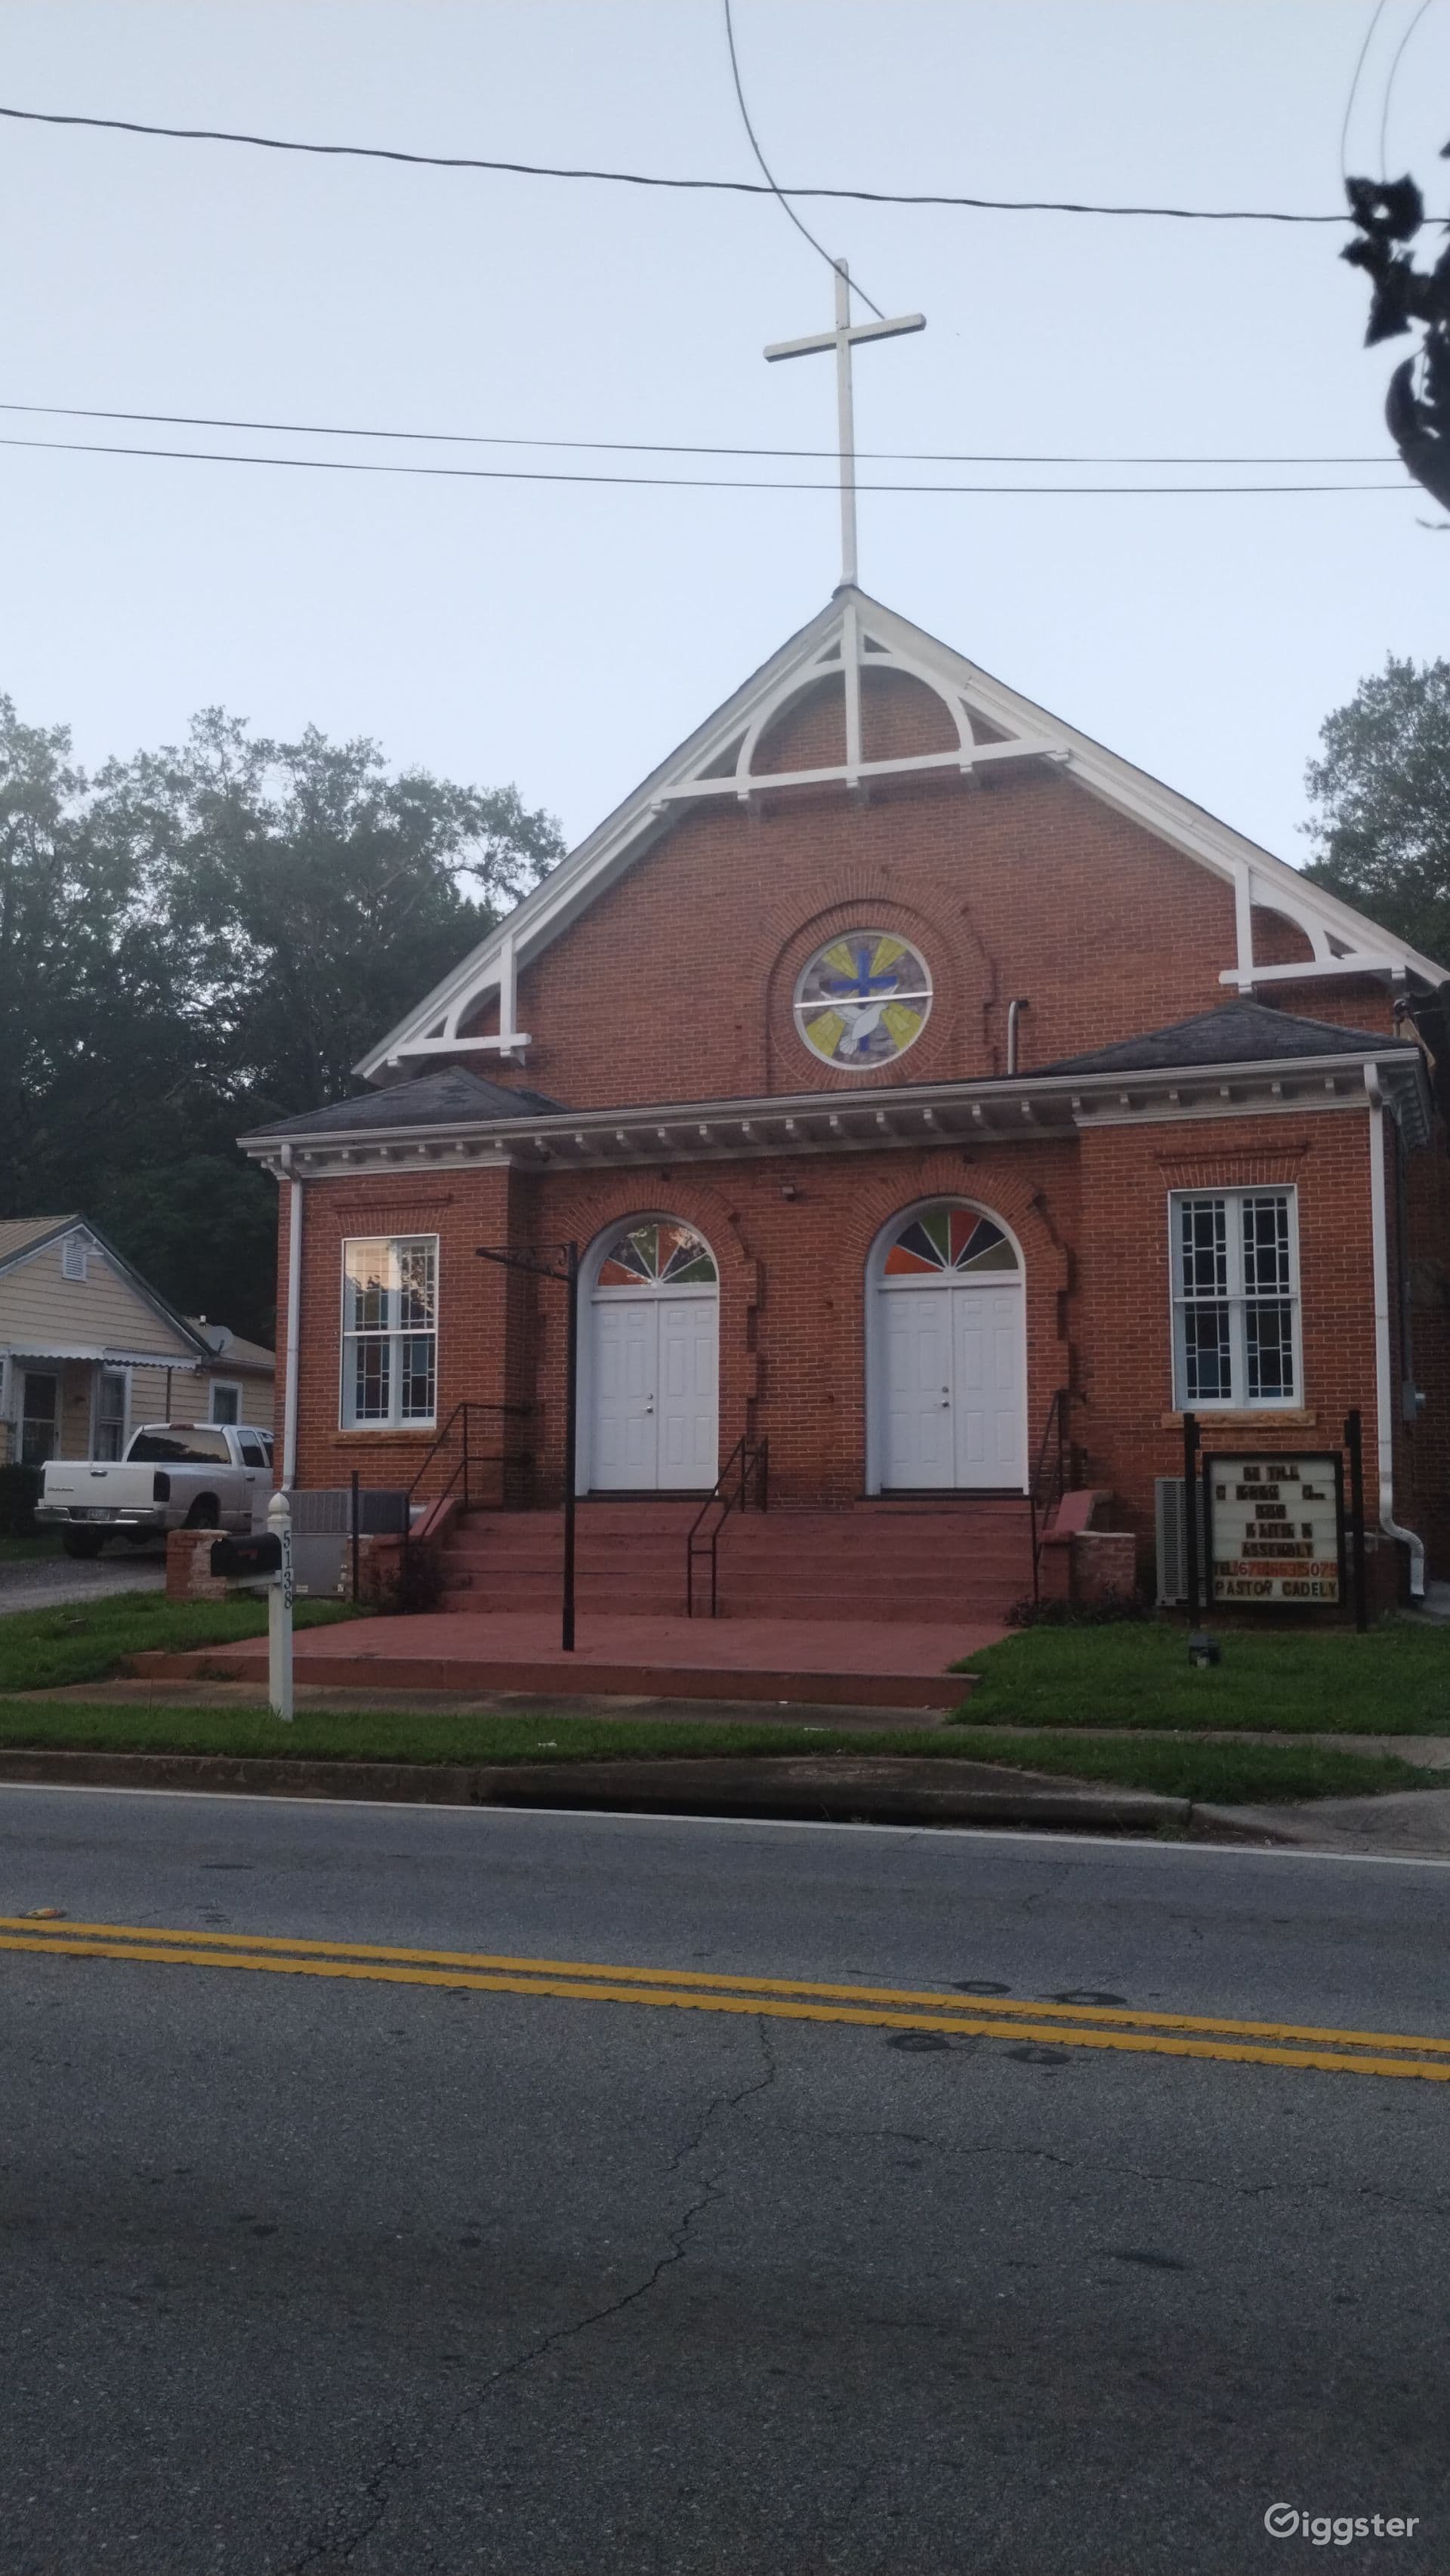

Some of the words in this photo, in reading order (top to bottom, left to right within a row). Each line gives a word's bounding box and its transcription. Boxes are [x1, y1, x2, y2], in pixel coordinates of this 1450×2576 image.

[283, 1530, 292, 1609] 5138
[1214, 1581, 1273, 1596] PASTOR
[1282, 1581, 1336, 1597] CADELY
